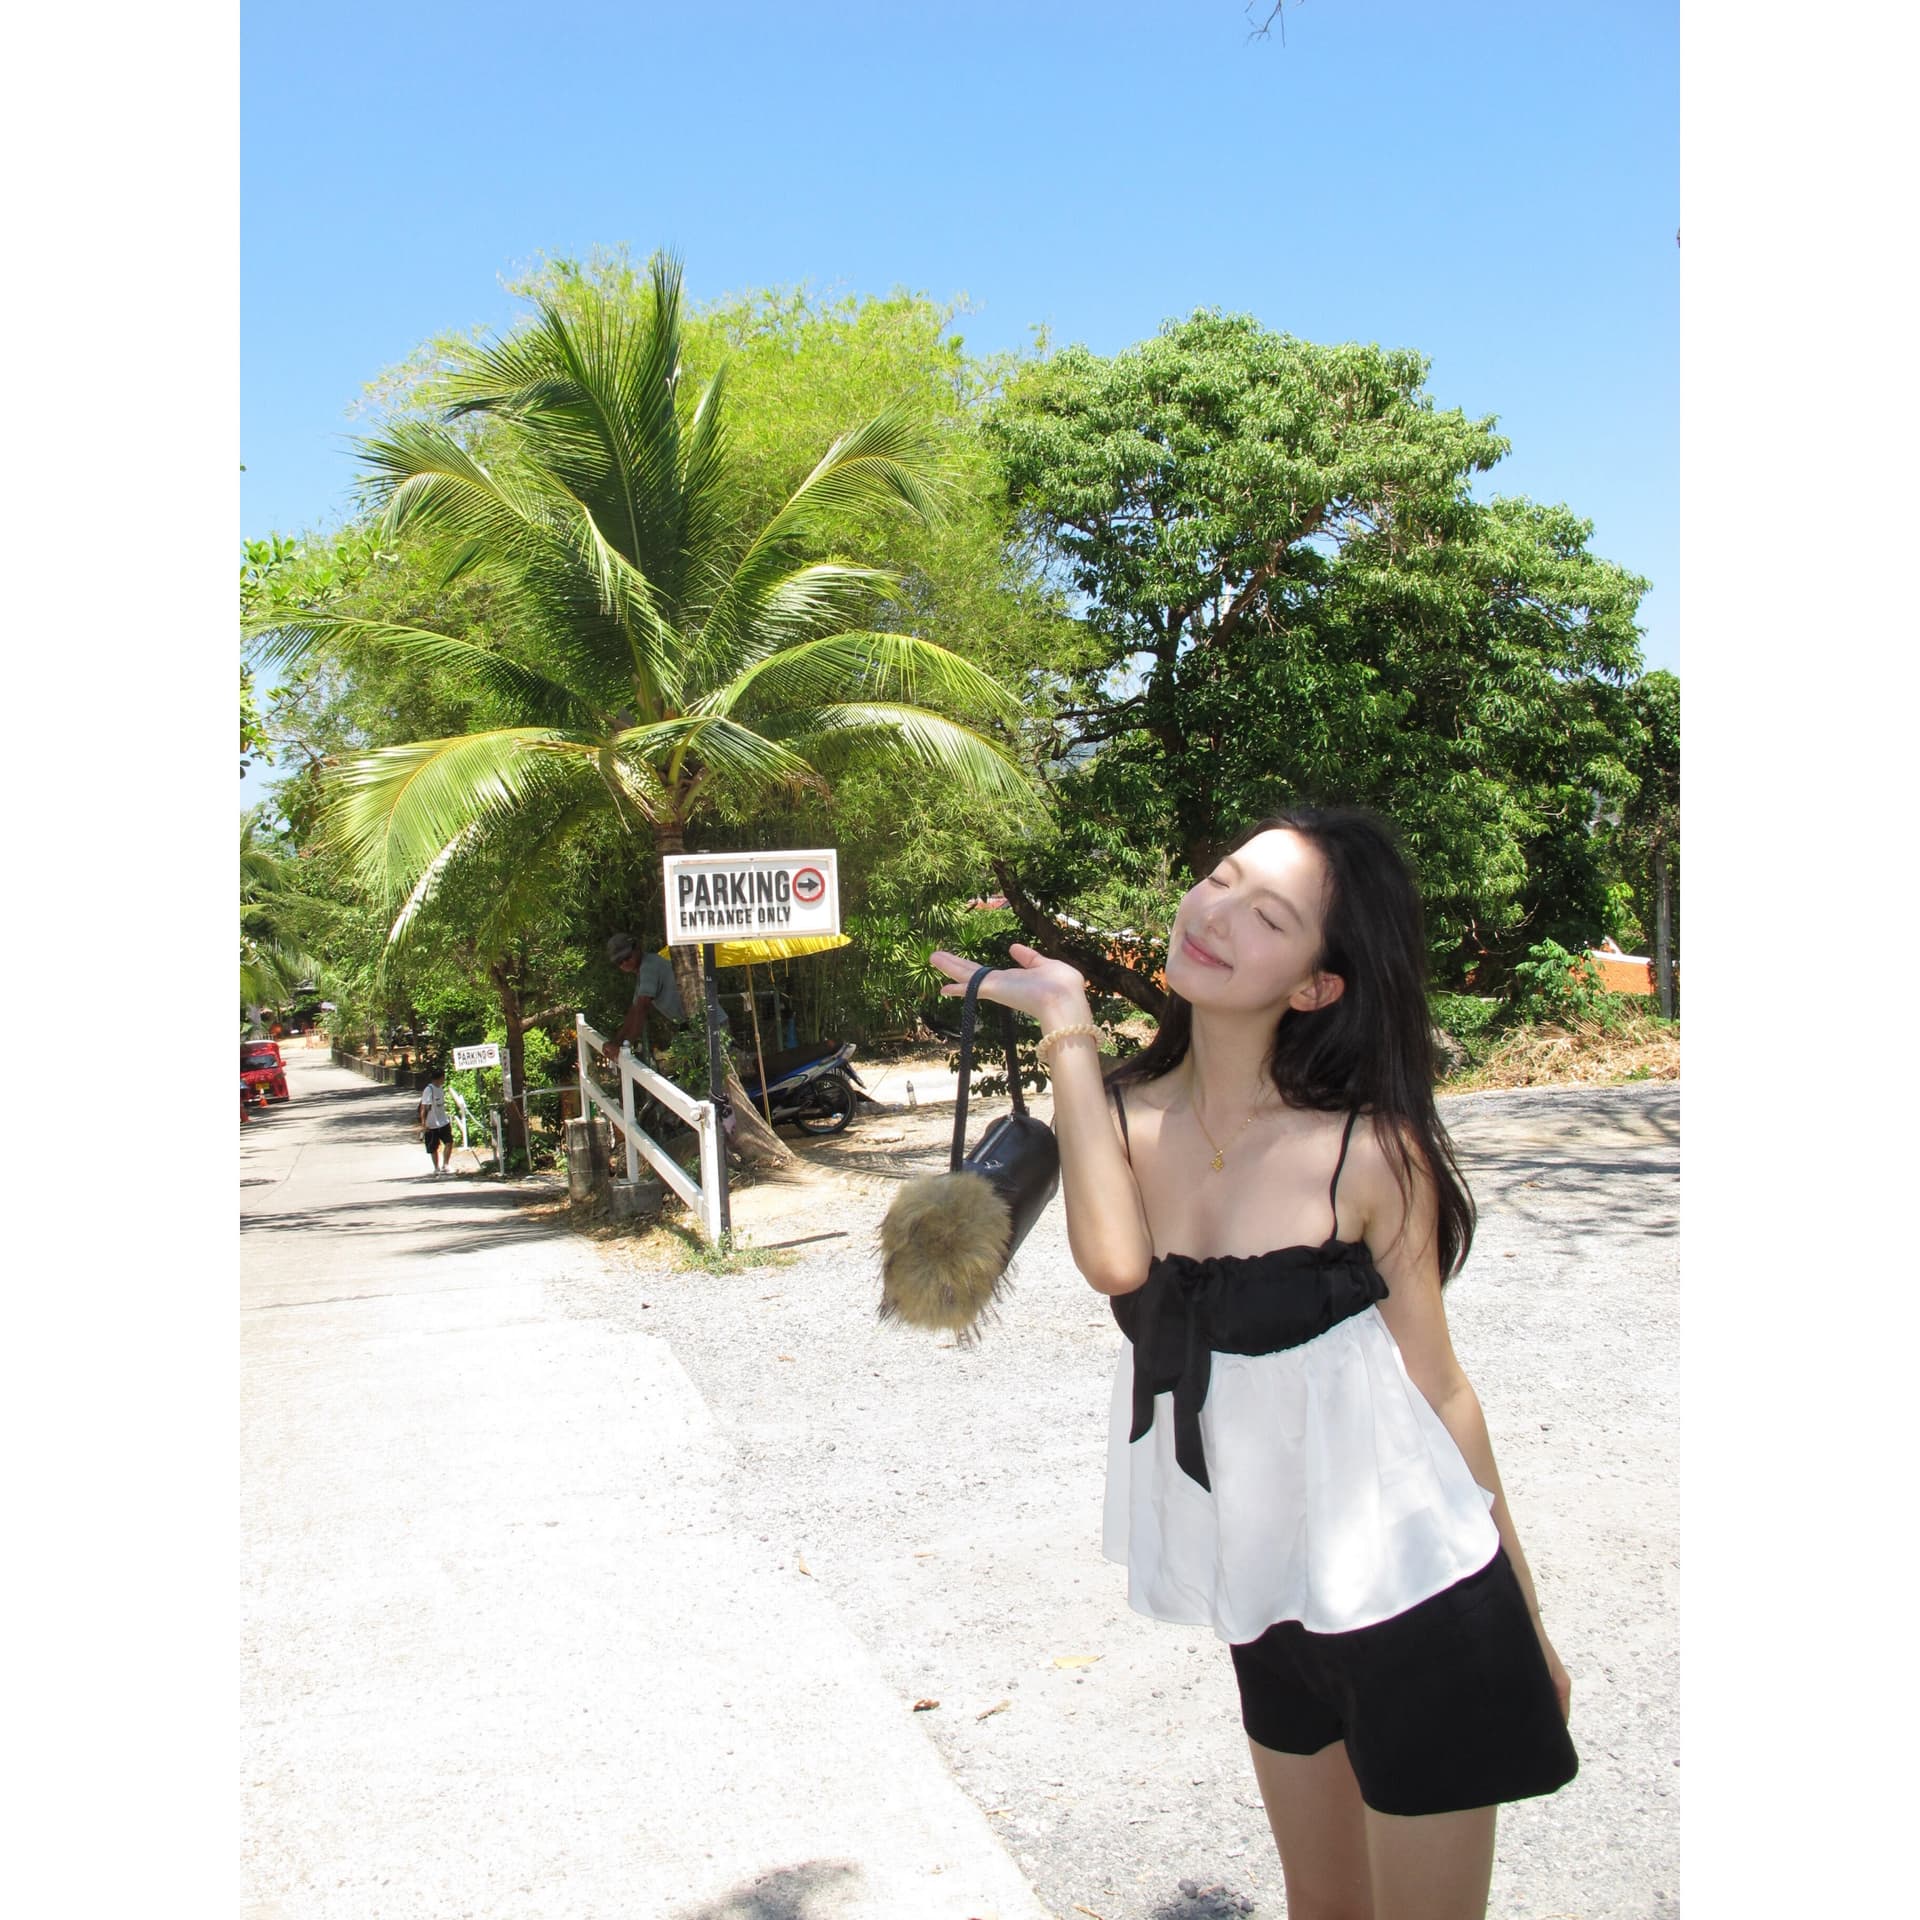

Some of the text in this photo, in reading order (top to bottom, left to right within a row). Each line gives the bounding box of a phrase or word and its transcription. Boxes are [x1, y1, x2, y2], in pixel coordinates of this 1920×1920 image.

[678, 871, 790, 907] PARKING
[680, 906, 791, 927] ENTRANCE ONLY
